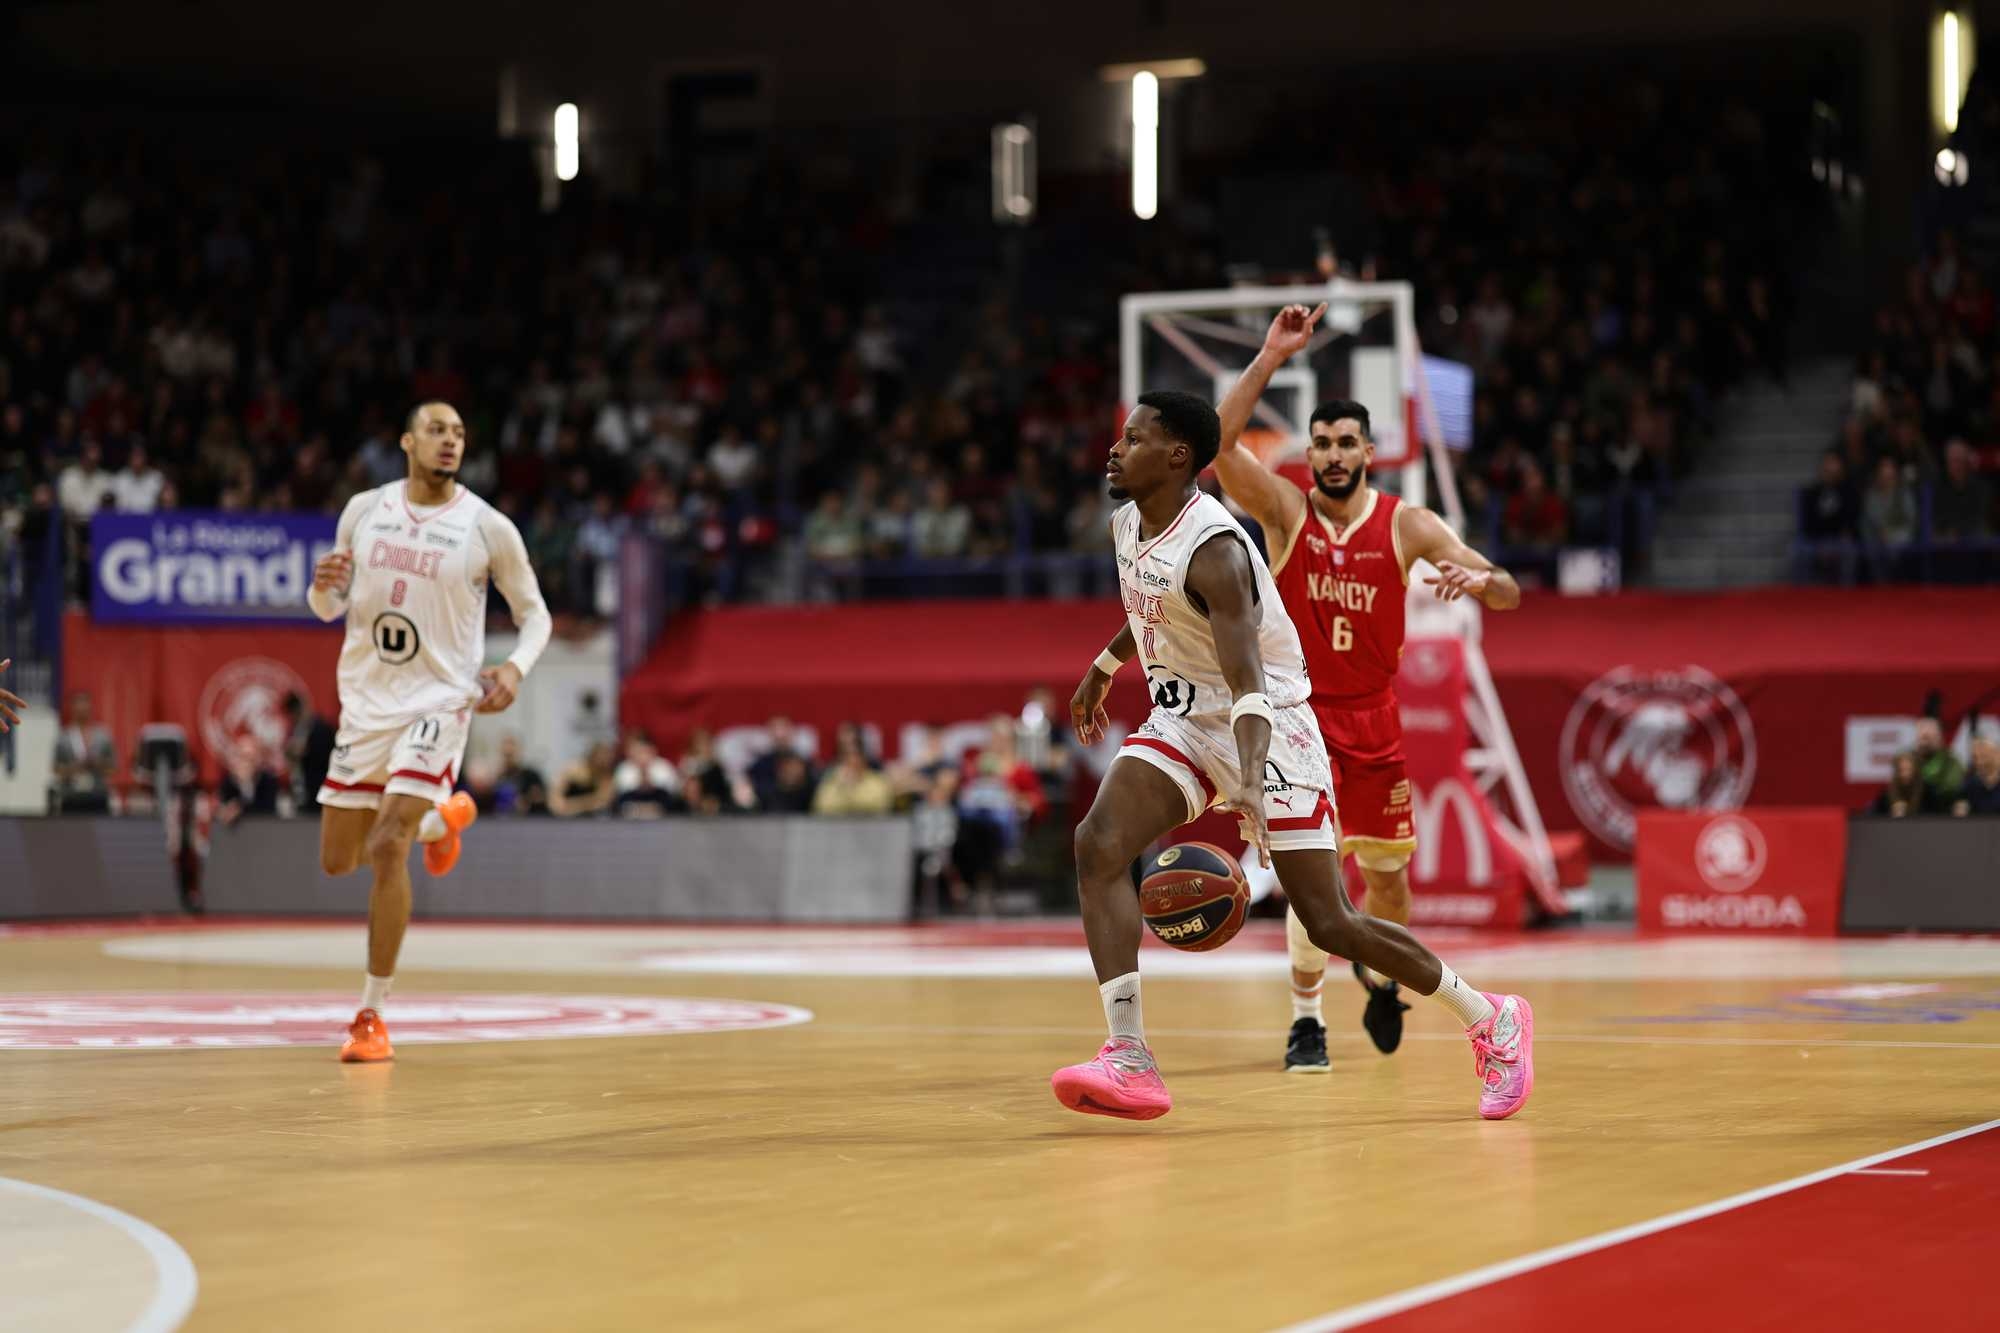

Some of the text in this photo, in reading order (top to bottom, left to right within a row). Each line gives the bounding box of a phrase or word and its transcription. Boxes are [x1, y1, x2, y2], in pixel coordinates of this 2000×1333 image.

[101, 537, 305, 606] Grand
[368, 539, 446, 580] CHOLET
[390, 579, 408, 607] 8
[1307, 573, 1378, 613] NANCY
[1143, 626, 1158, 660] 11
[1332, 615, 1353, 651] 6
[1155, 917, 1204, 940] Betclic
